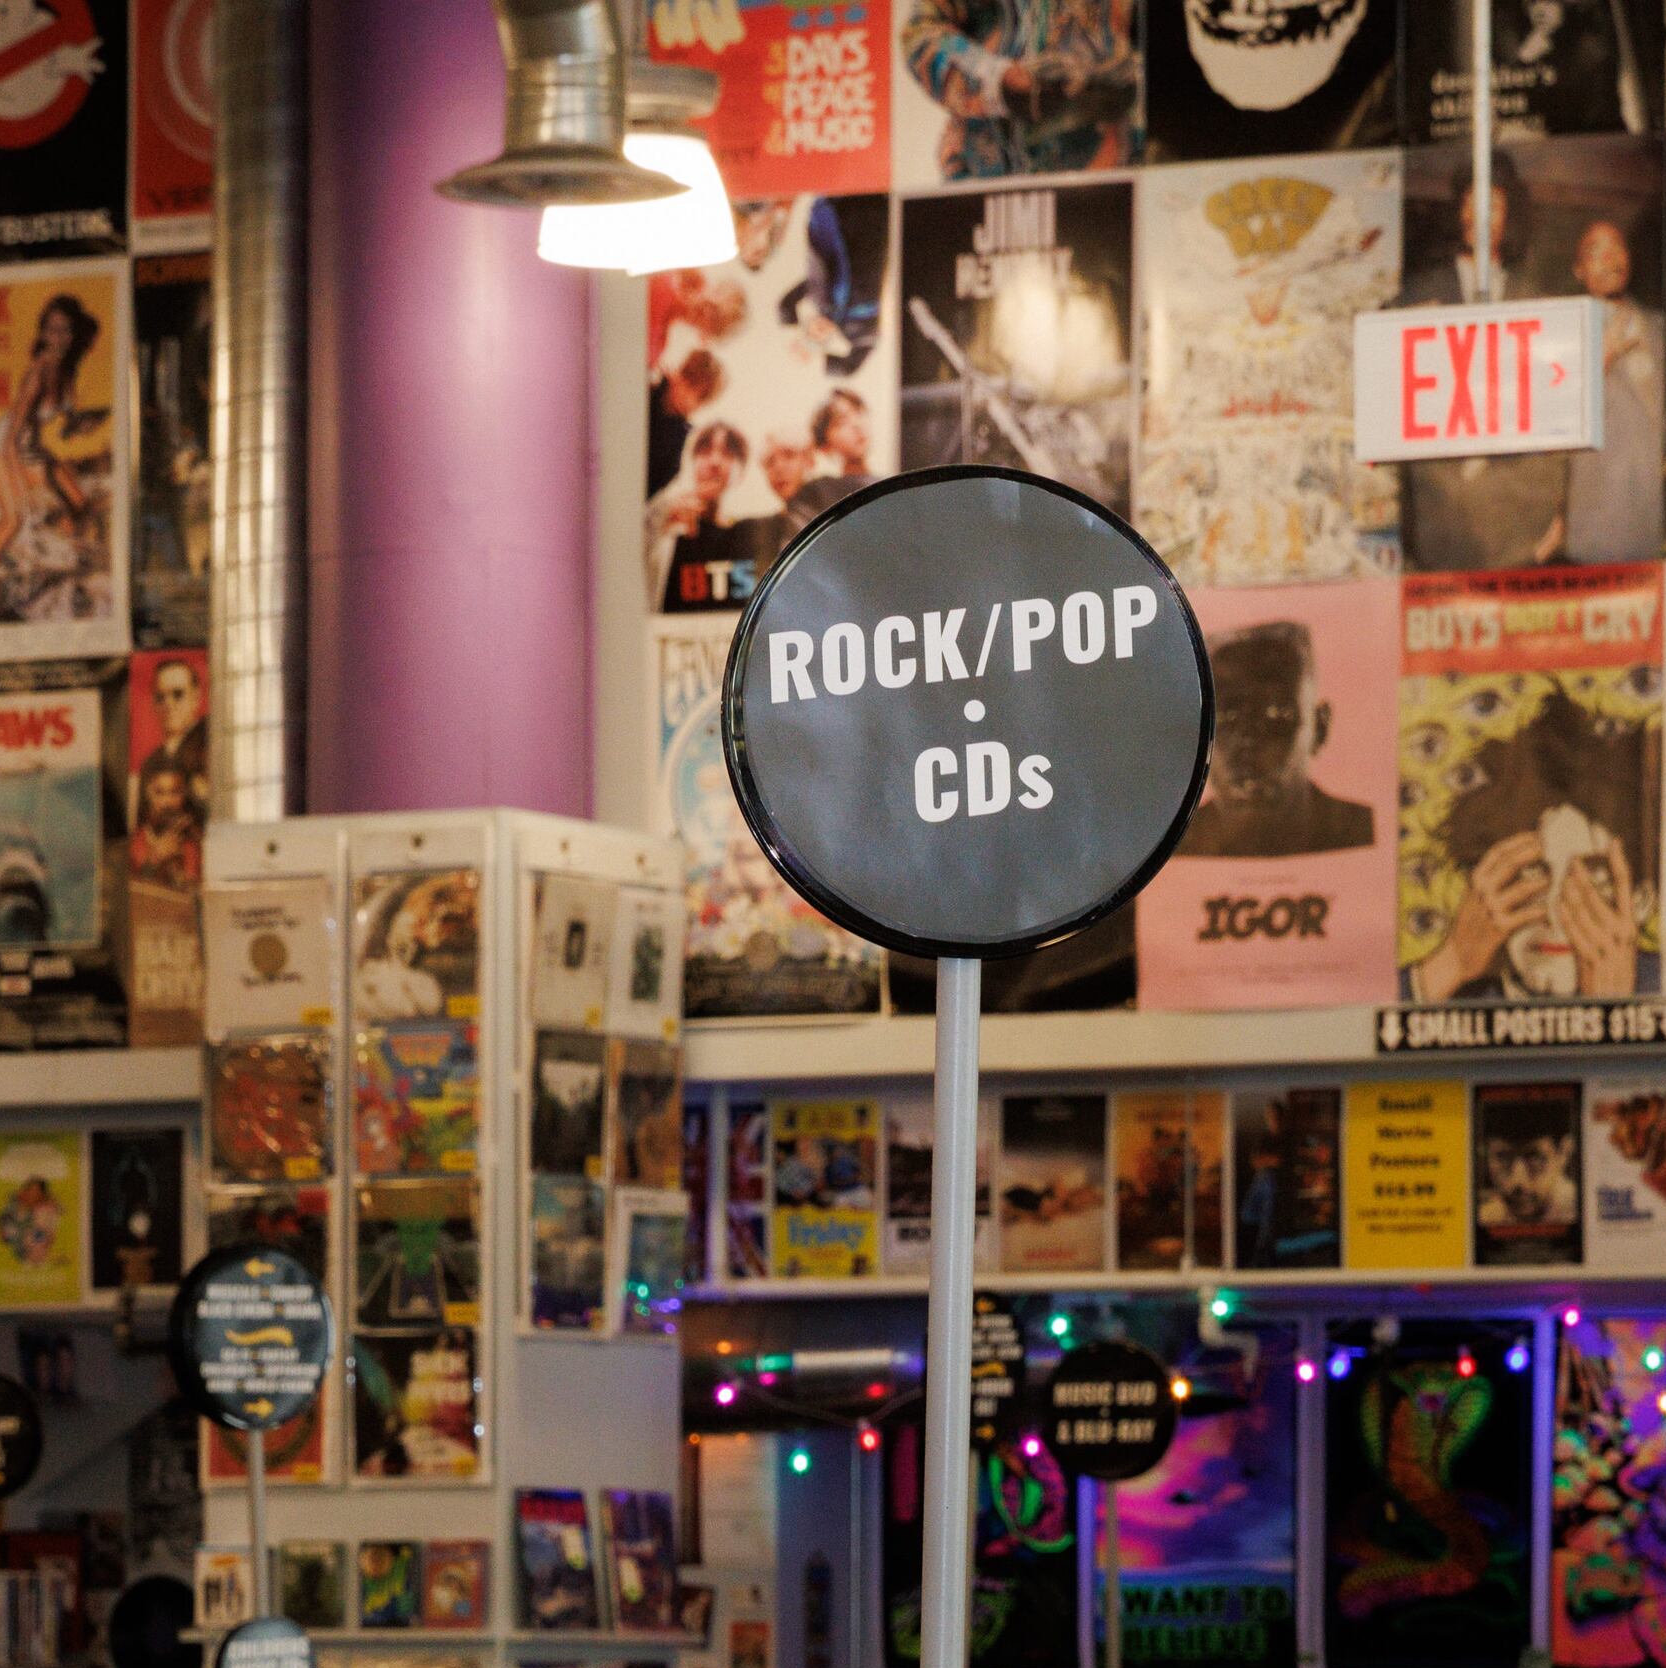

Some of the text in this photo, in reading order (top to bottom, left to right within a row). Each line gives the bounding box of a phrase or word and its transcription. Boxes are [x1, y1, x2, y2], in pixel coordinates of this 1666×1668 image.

[785, 31, 870, 77] DAYS
[785, 74, 875, 119] PEACE
[785, 115, 874, 155] MUSIC
[1401, 319, 1542, 441] EXIT
[679, 562, 756, 600] BTS
[768, 585, 1157, 705] ROCK/POP
[1407, 604, 1500, 652] BOYS
[1584, 597, 1660, 644] CRY
[914, 740, 1054, 823] CDs
[1199, 894, 1329, 942] IGOR
[1407, 1010, 1489, 1048] SMALL
[1493, 1007, 1603, 1046] POSTERS
[1053, 1381, 1157, 1407] MUSIC DVD
[1074, 1418, 1156, 1444] BLU-RAY
